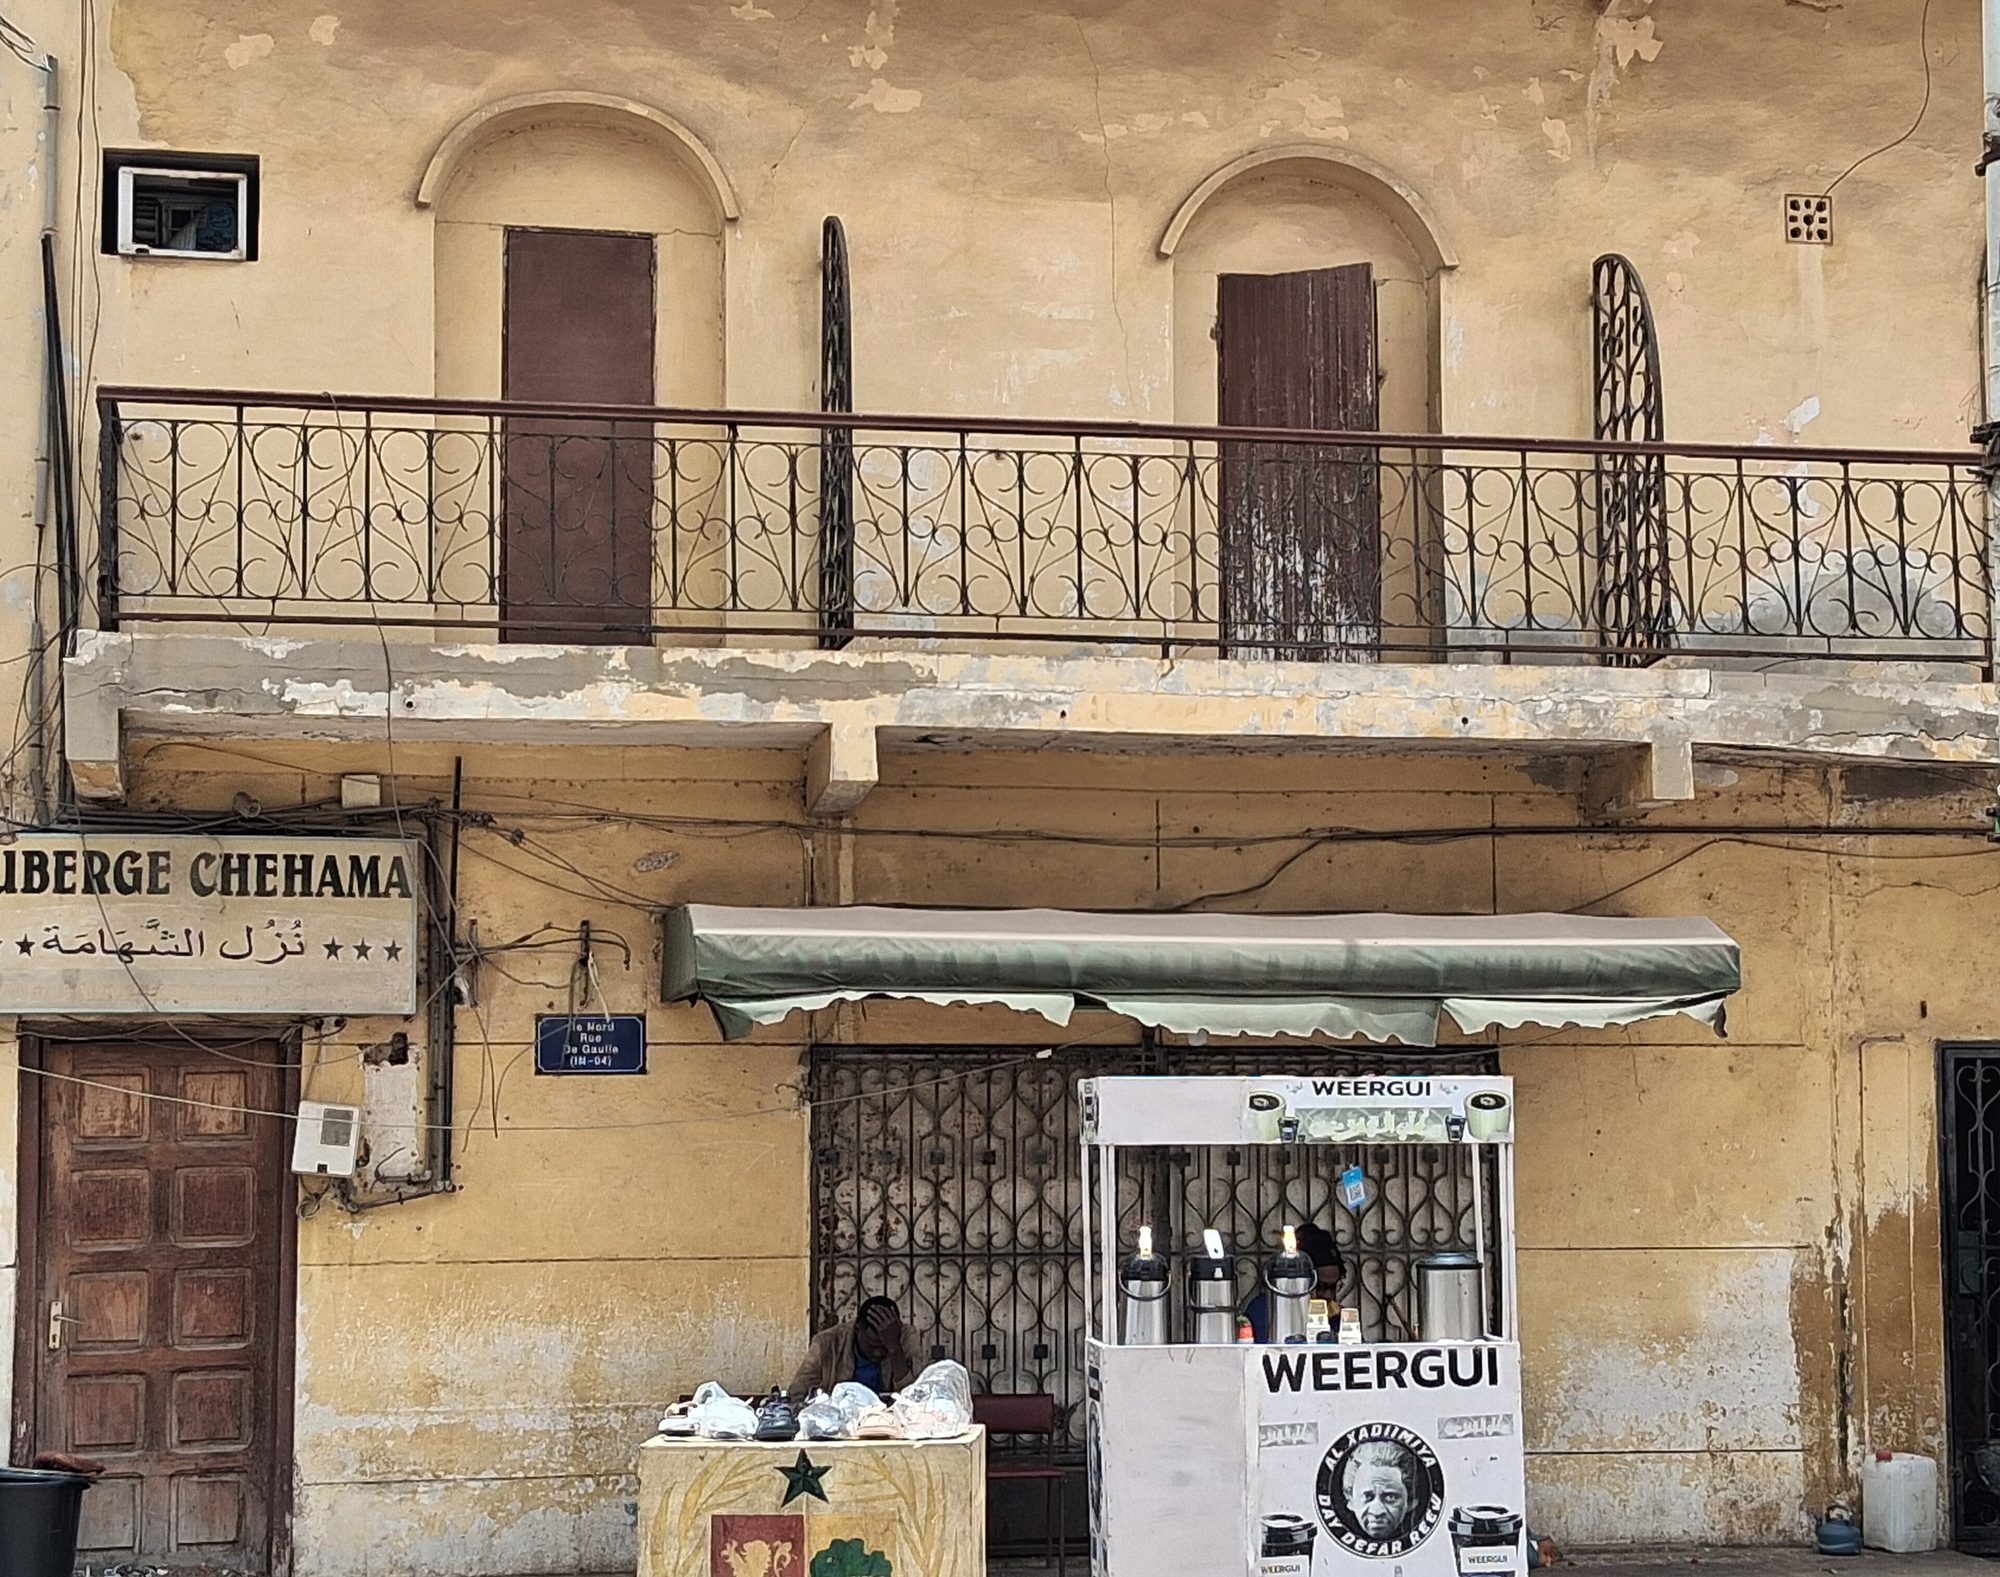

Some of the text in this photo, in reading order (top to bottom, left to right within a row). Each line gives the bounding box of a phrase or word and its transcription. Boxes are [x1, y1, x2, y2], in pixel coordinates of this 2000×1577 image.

[190, 852, 412, 899] CHEHAMA
[580, 1033, 602, 1043] Rue
[587, 1021, 615, 1032] Nord
[582, 1044, 619, 1054] Gaulle
[1311, 1080, 1431, 1097] WEERGUI
[1262, 1347, 1499, 1393] WEERGUI
[1325, 1448, 1343, 1471] AL
[1347, 1424, 1437, 1468] XADIIMIYA
[1317, 1494, 1343, 1528] DAY
[1340, 1532, 1402, 1555] DEFAR
